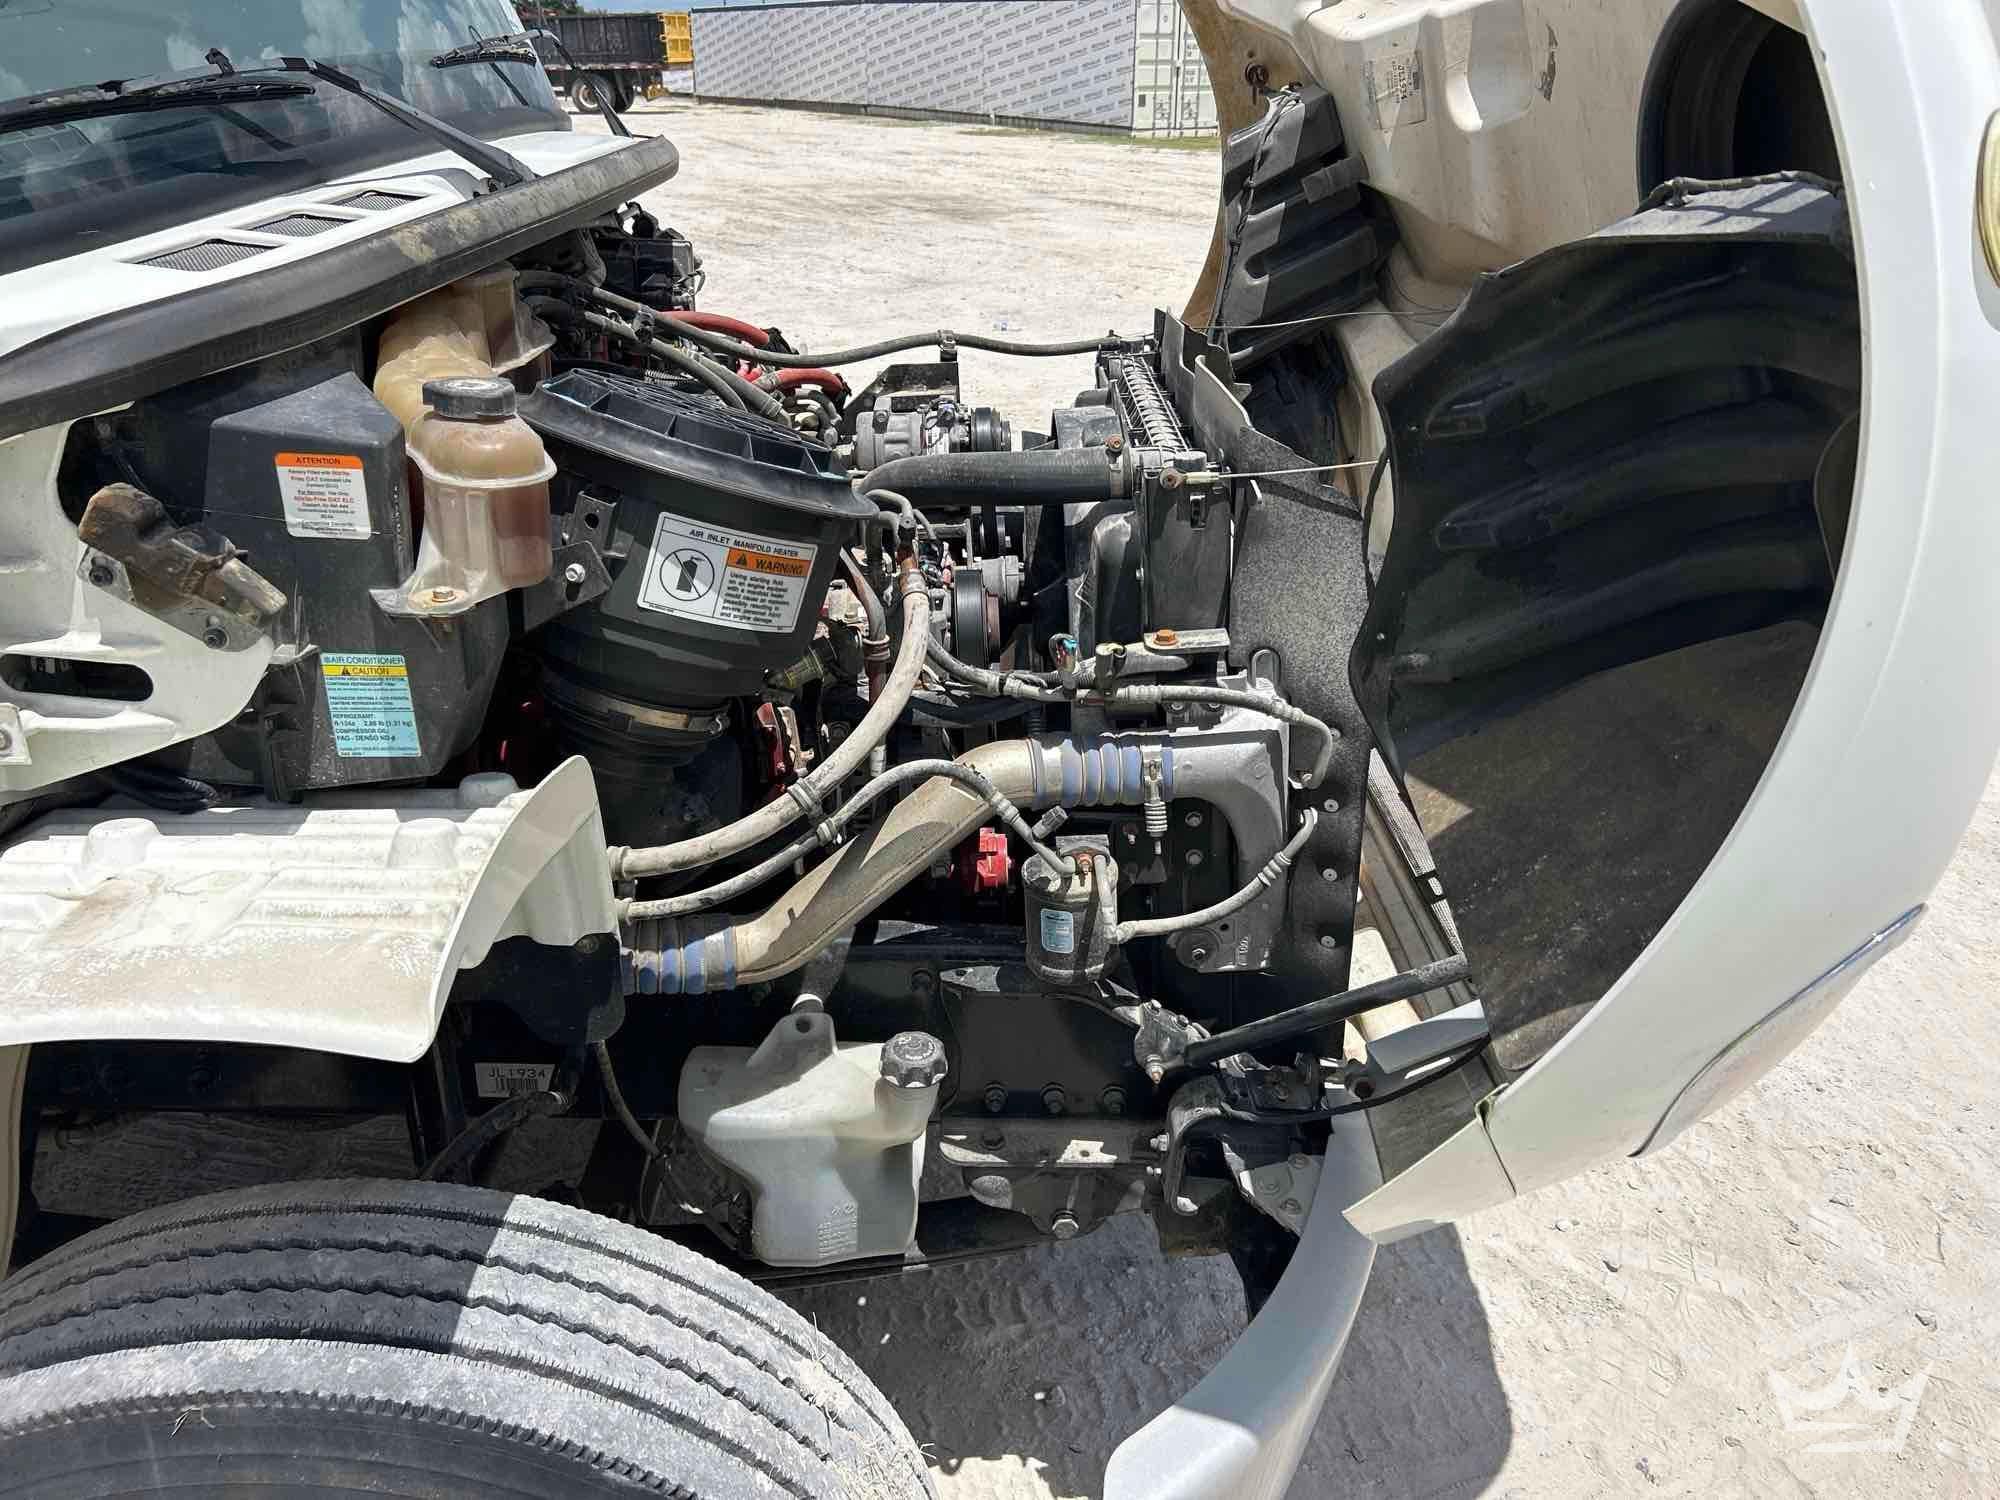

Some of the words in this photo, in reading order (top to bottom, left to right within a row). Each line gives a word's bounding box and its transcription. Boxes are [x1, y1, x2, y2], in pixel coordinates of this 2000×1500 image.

[296, 456, 340, 464] ATTENTION
[689, 529, 704, 539] AIR
[706, 534, 730, 545] INLET
[733, 539, 771, 552] MANIFOLD
[773, 547, 799, 557] HEATER
[756, 559, 804, 575] WARNING
[730, 571, 747, 581] Using
[345, 656, 404, 664] CONDITIONER
[488, 1068, 545, 1078] JL1934
